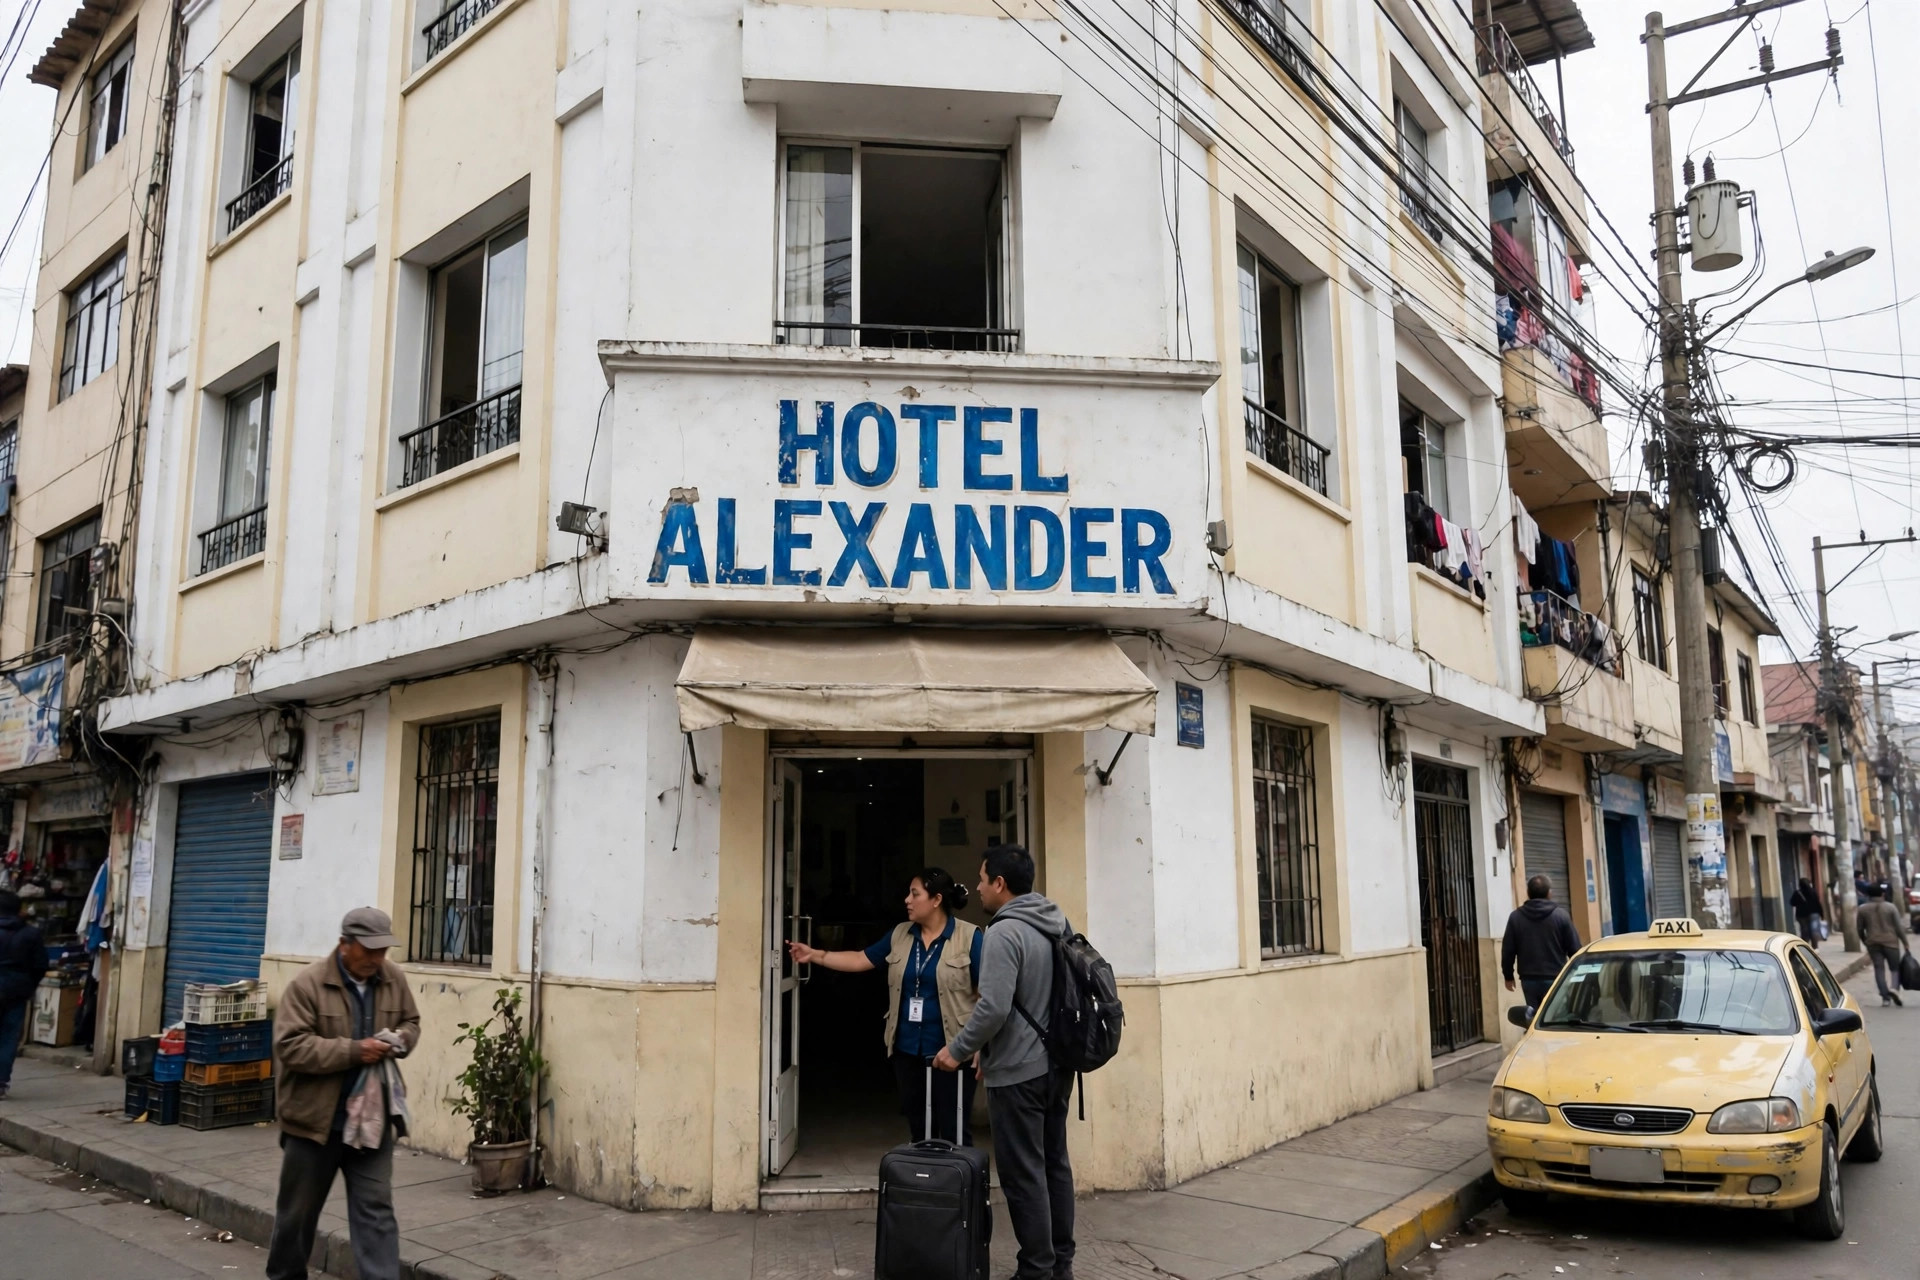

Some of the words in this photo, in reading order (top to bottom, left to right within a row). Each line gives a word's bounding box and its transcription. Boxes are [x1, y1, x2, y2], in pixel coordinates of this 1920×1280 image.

[777, 399, 1069, 493] HOTEL
[646, 497, 1177, 595] ALEXANDER
[1655, 921, 1691, 934] TAXI
